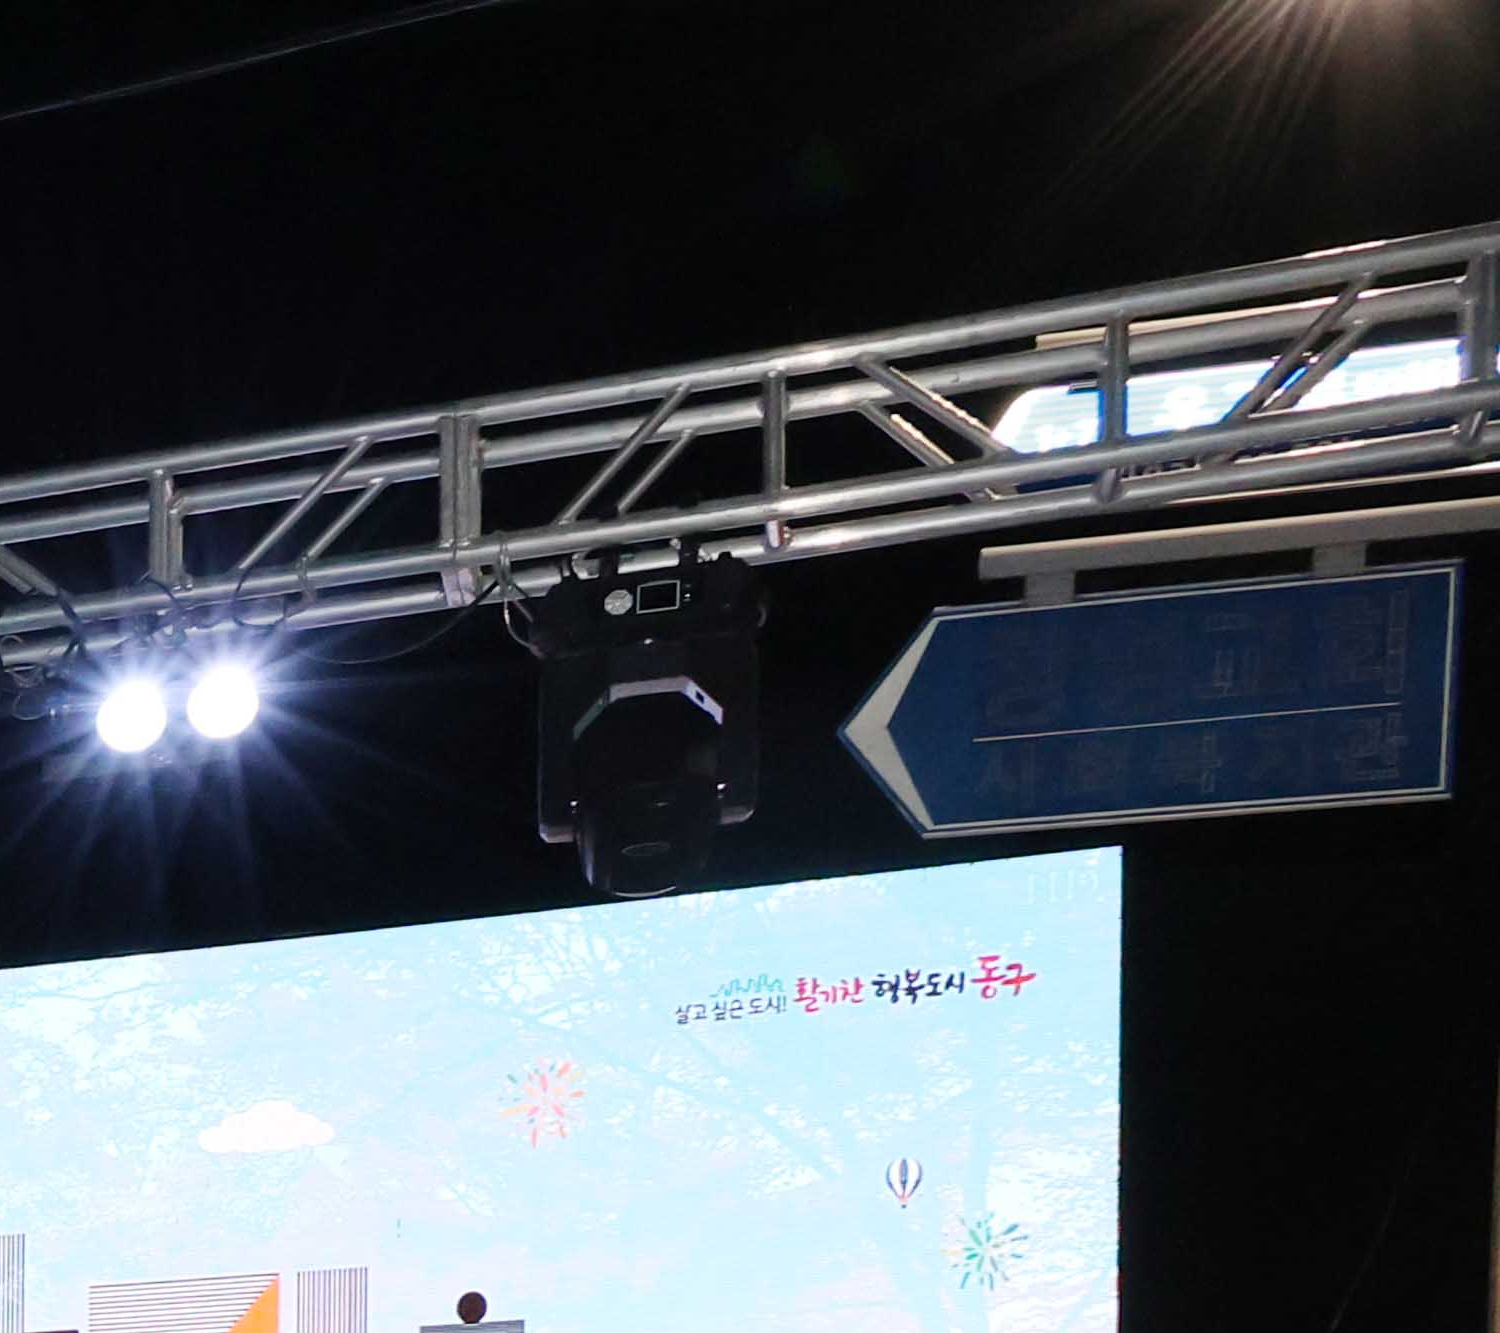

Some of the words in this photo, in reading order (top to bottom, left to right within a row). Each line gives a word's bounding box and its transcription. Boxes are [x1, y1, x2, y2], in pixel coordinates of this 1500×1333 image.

[711, 999, 745, 1021] 싶은
[748, 996, 788, 1016] 도시!
[793, 976, 865, 1013] 활기찬
[871, 968, 965, 1005] 행복도시
[971, 955, 1037, 1000] 동구
